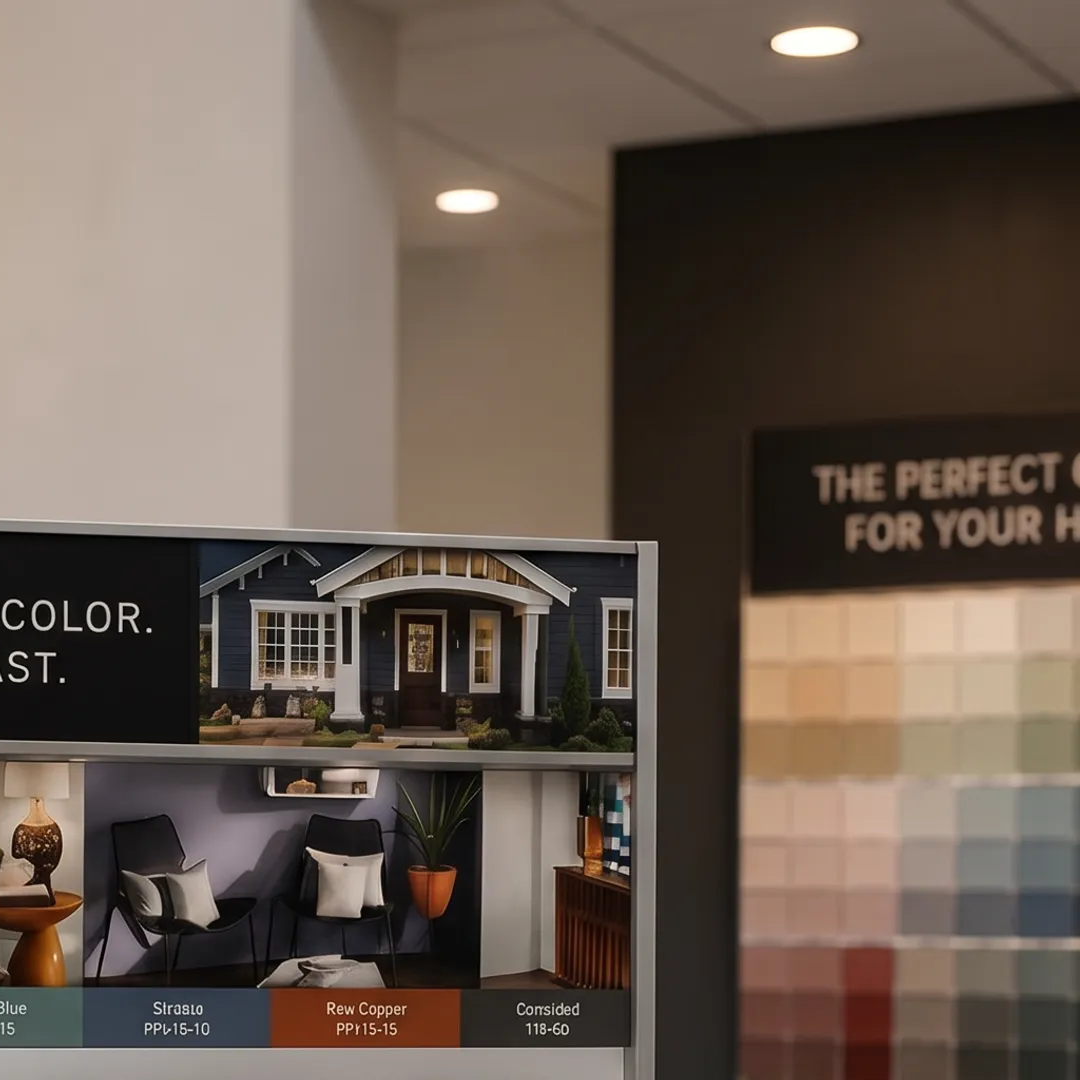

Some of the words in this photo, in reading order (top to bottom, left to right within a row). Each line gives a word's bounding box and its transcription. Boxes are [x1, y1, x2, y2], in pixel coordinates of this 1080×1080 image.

[813, 462, 886, 504] THE
[895, 452, 1063, 500] PERFECT
[845, 510, 923, 552] FOR
[932, 504, 1043, 550] YOUR
[1, 599, 153, 635] COLOR.
[359, 1002, 407, 1019] Copper
[525, 1023, 570, 1036] 118-60
